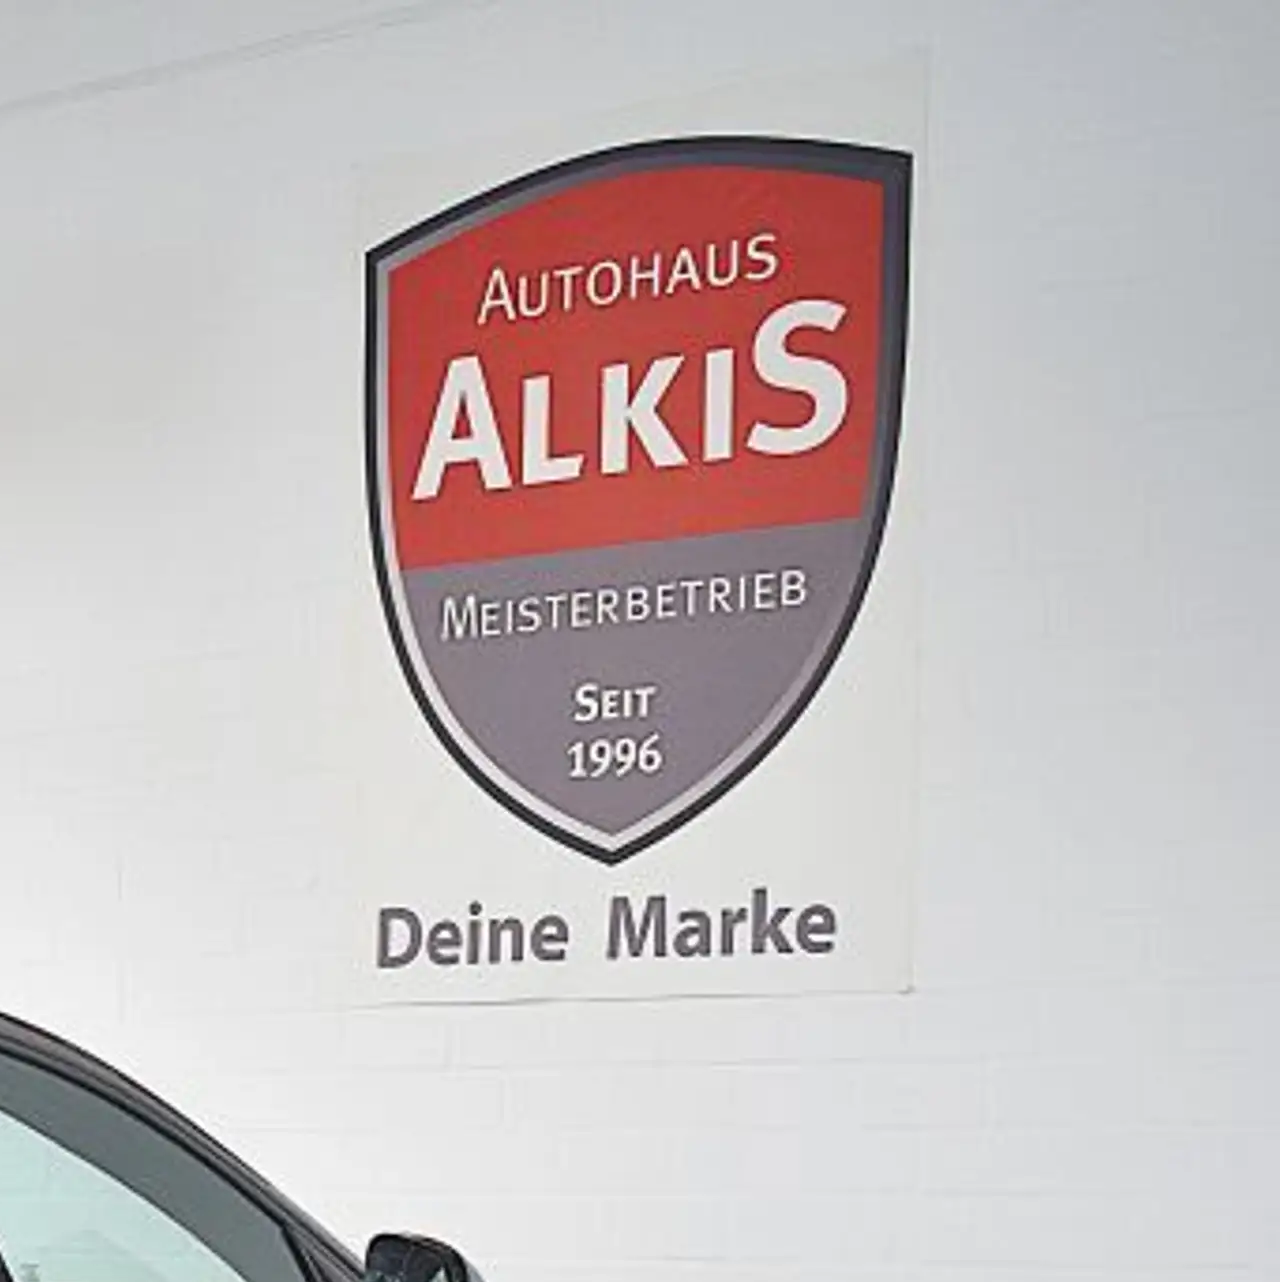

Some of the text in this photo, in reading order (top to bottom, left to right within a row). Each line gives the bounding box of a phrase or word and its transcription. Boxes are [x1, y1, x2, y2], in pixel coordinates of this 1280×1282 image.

[478, 233, 779, 325] AUTOHAUS
[411, 299, 848, 501] ALKIS
[441, 570, 807, 641] MEISTERBETRIEB
[573, 682, 658, 722] SEIT
[567, 735, 663, 778] 1996
[376, 887, 838, 969] Deine Marke
